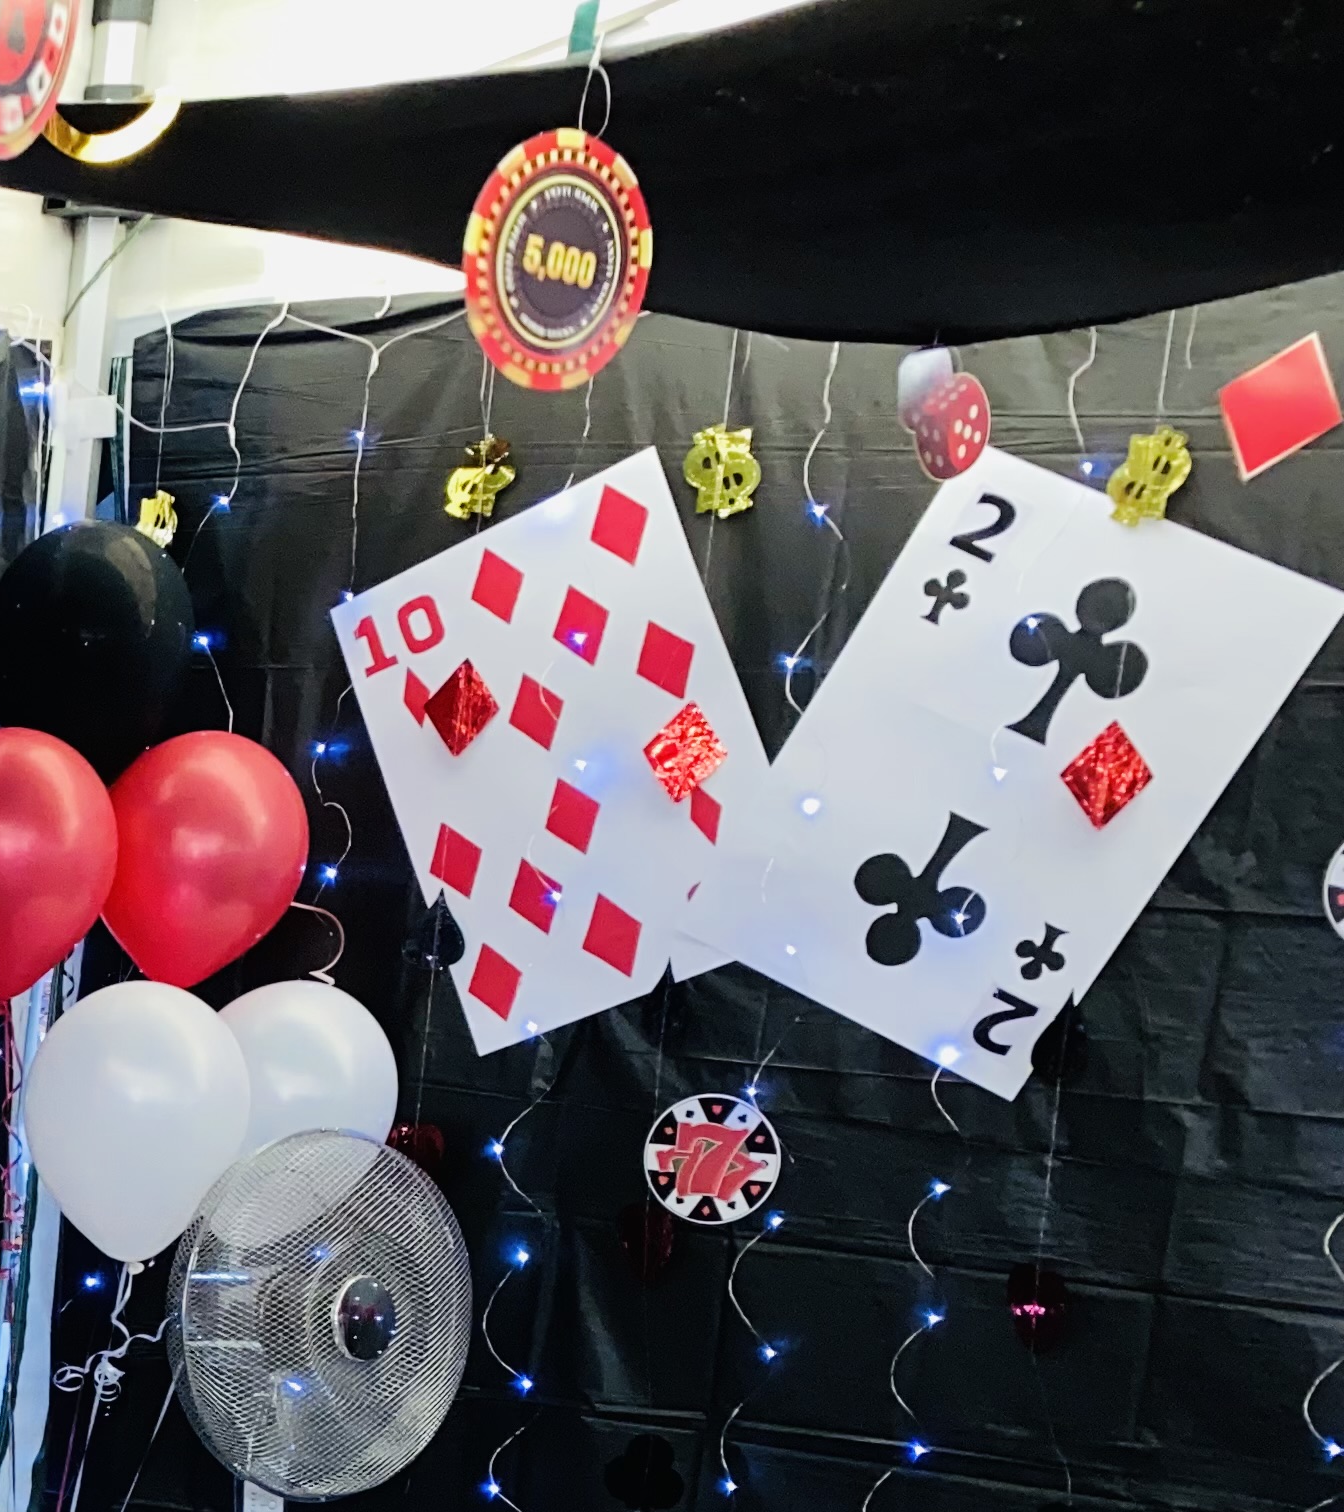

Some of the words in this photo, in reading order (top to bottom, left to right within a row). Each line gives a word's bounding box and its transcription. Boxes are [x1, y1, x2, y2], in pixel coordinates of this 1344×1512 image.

[523, 233, 597, 290] 5,000
[949, 493, 1016, 564] 2
[353, 595, 445, 679] 10
[970, 989, 1039, 1057] 2
